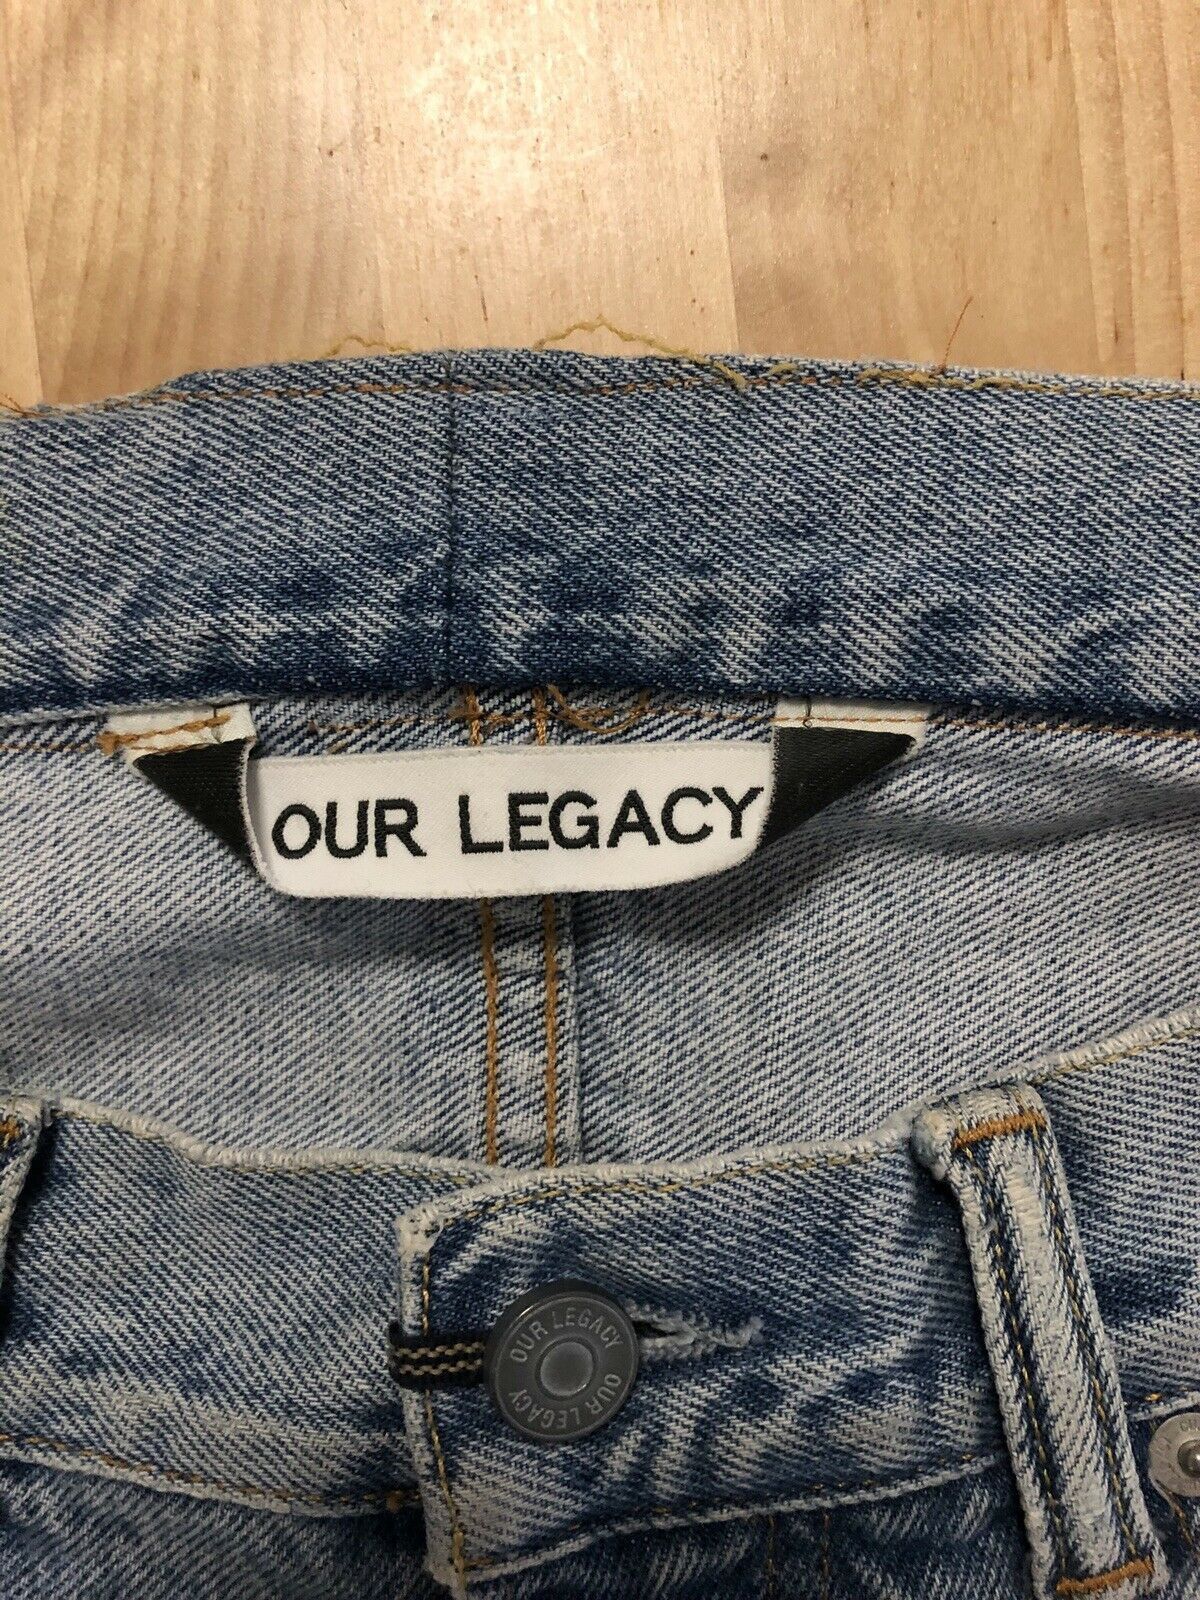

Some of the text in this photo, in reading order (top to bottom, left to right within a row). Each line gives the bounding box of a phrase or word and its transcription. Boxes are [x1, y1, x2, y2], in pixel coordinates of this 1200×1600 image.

[271, 786, 764, 859] OUR LEGACY
[510, 1307, 623, 1362] OUR LEGACY
[509, 1374, 622, 1429] OUR LEGACY
